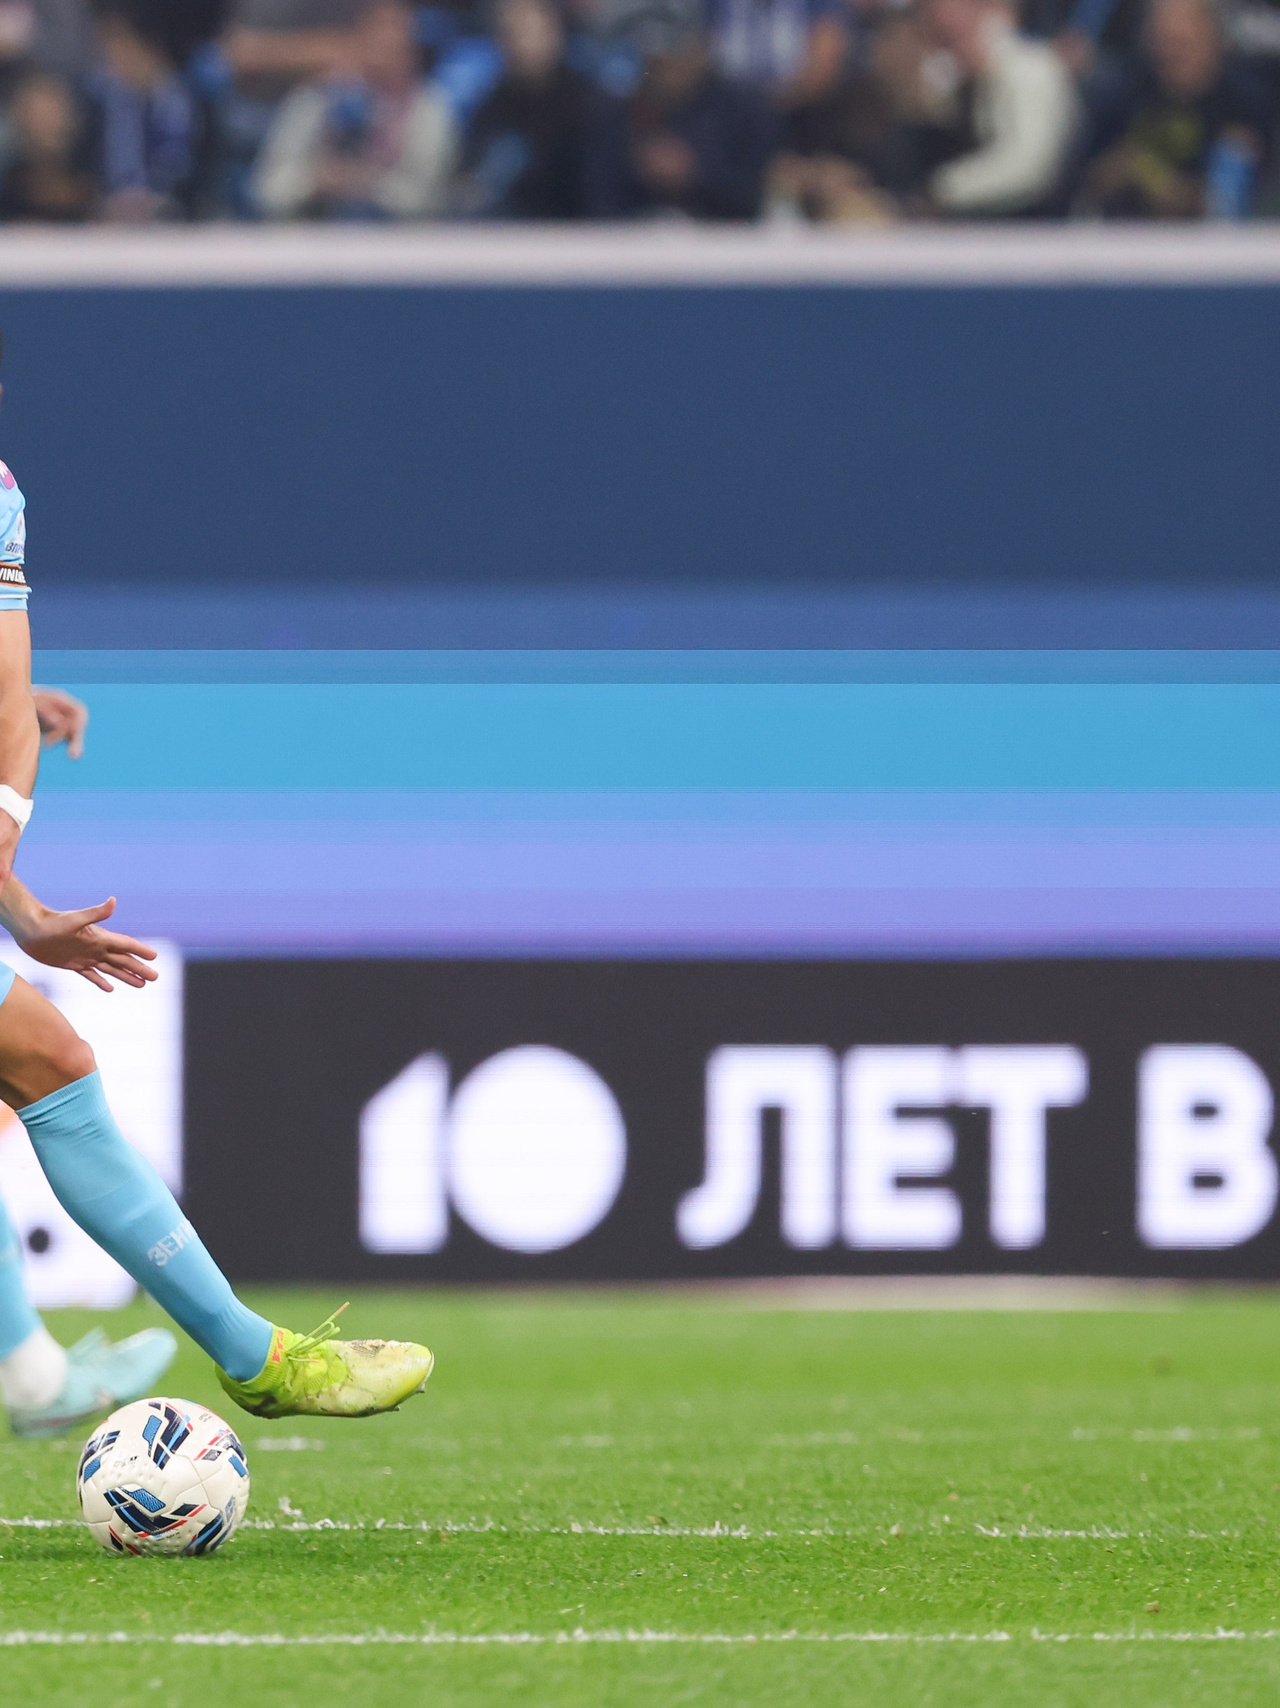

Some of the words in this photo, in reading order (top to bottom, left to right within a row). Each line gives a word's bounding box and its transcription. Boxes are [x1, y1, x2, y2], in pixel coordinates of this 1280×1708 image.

[358, 1046, 628, 1254] 10
[675, 1044, 1089, 1249] ЛЕТ
[1136, 1043, 1278, 1249] В
